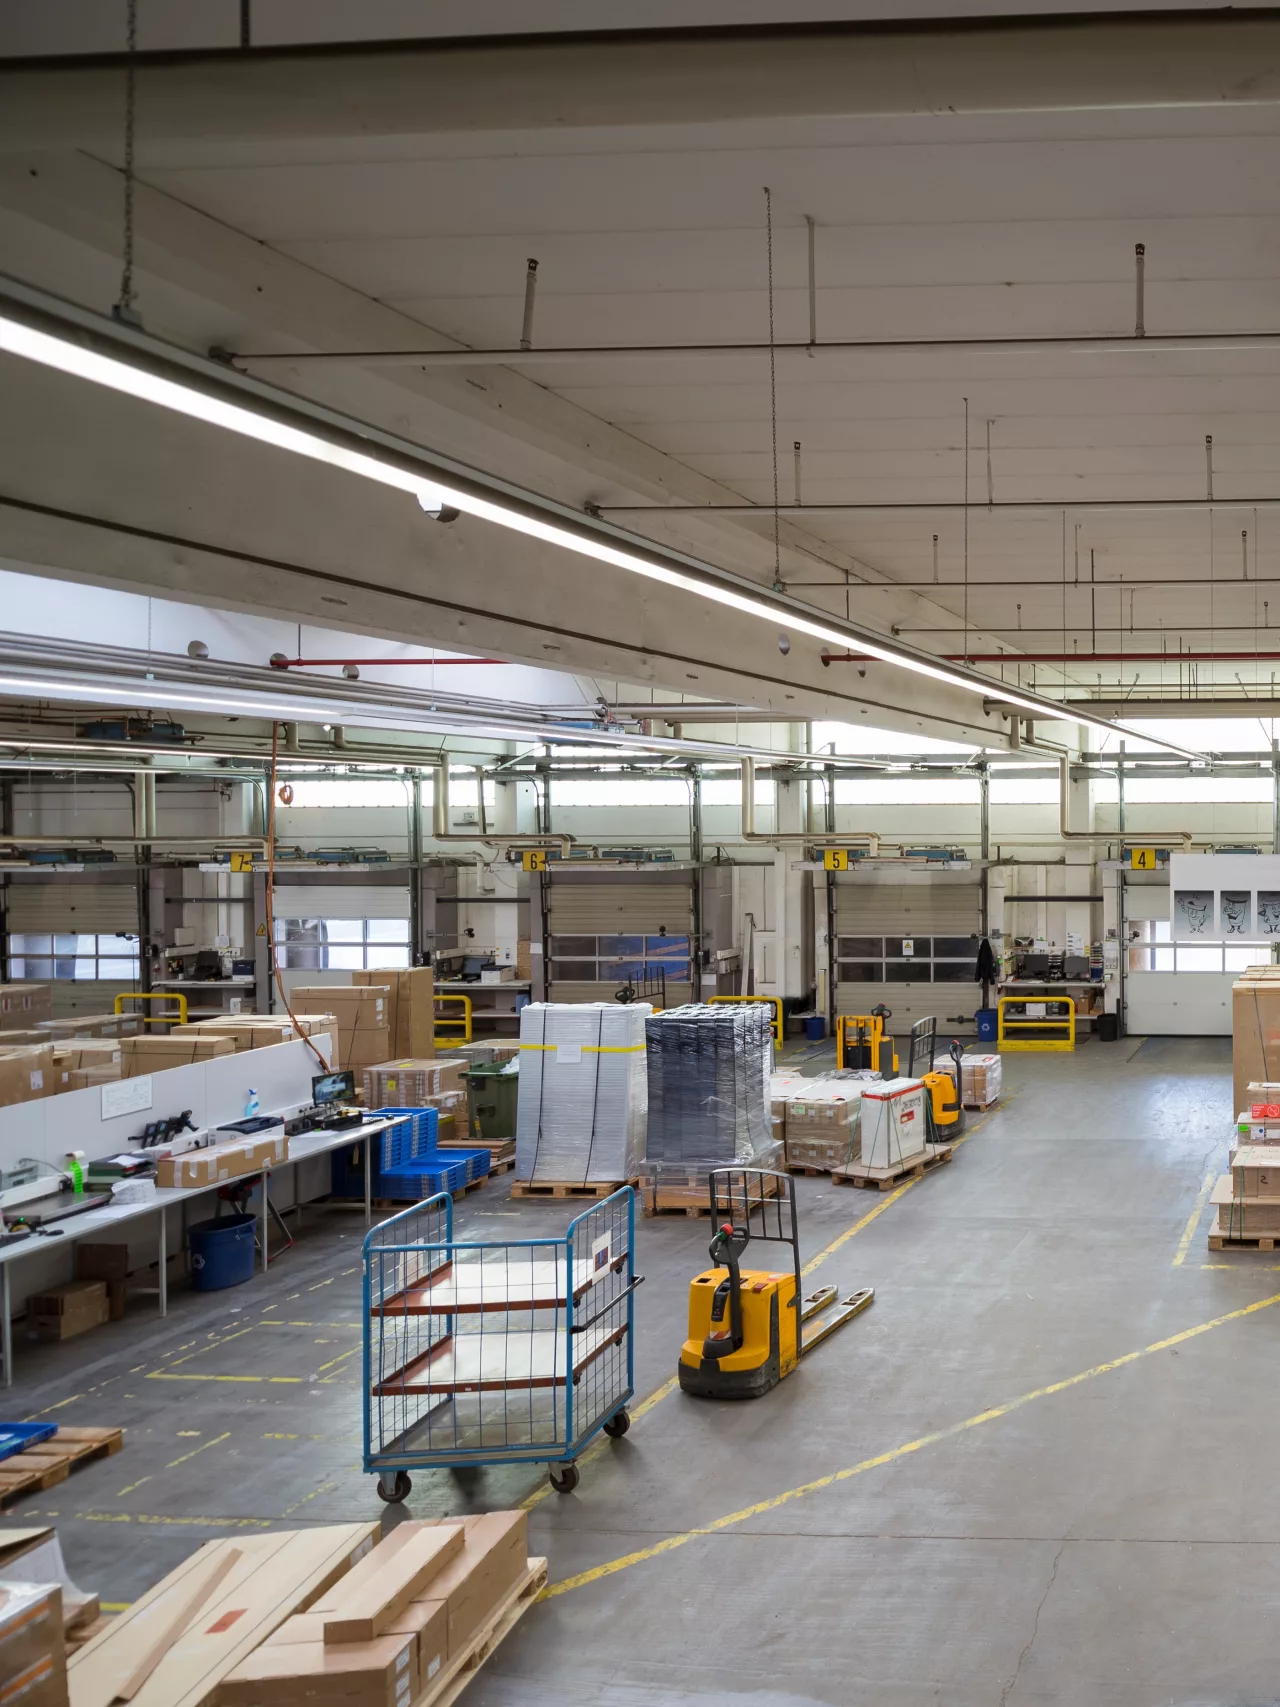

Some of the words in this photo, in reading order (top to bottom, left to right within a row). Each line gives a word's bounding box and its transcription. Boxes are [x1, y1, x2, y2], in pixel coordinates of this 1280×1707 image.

[238, 855, 244, 870] 7
[531, 853, 538, 869] 6
[833, 852, 840, 869] 5
[1138, 852, 1146, 868] 4
